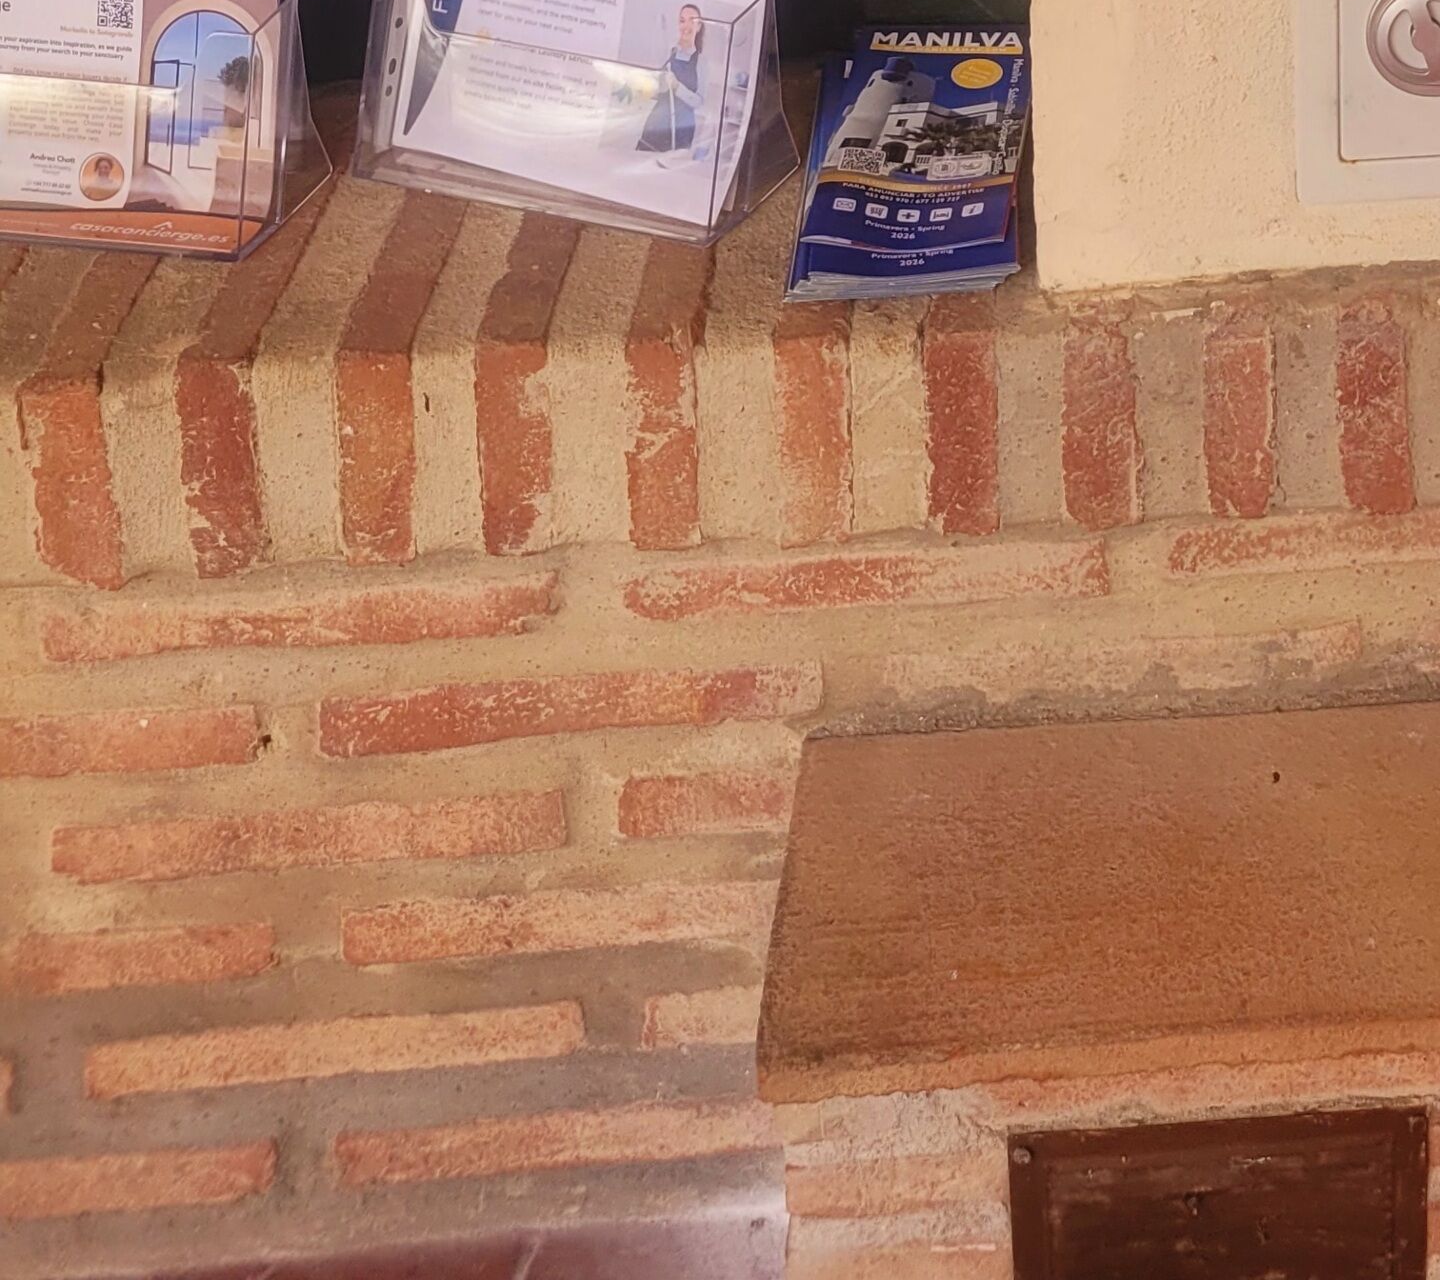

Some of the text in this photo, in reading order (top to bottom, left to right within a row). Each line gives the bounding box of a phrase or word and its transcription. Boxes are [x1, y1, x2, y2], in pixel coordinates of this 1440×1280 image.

[872, 31, 1024, 49] MANILVA
[843, 182, 866, 191] PARA
[868, 187, 914, 199] ANUNCIAR
[864, 219, 946, 232] Primavera Spring
[890, 231, 916, 240] 2026
[871, 251, 917, 259] Primavera
[899, 259, 925, 267] 2026
